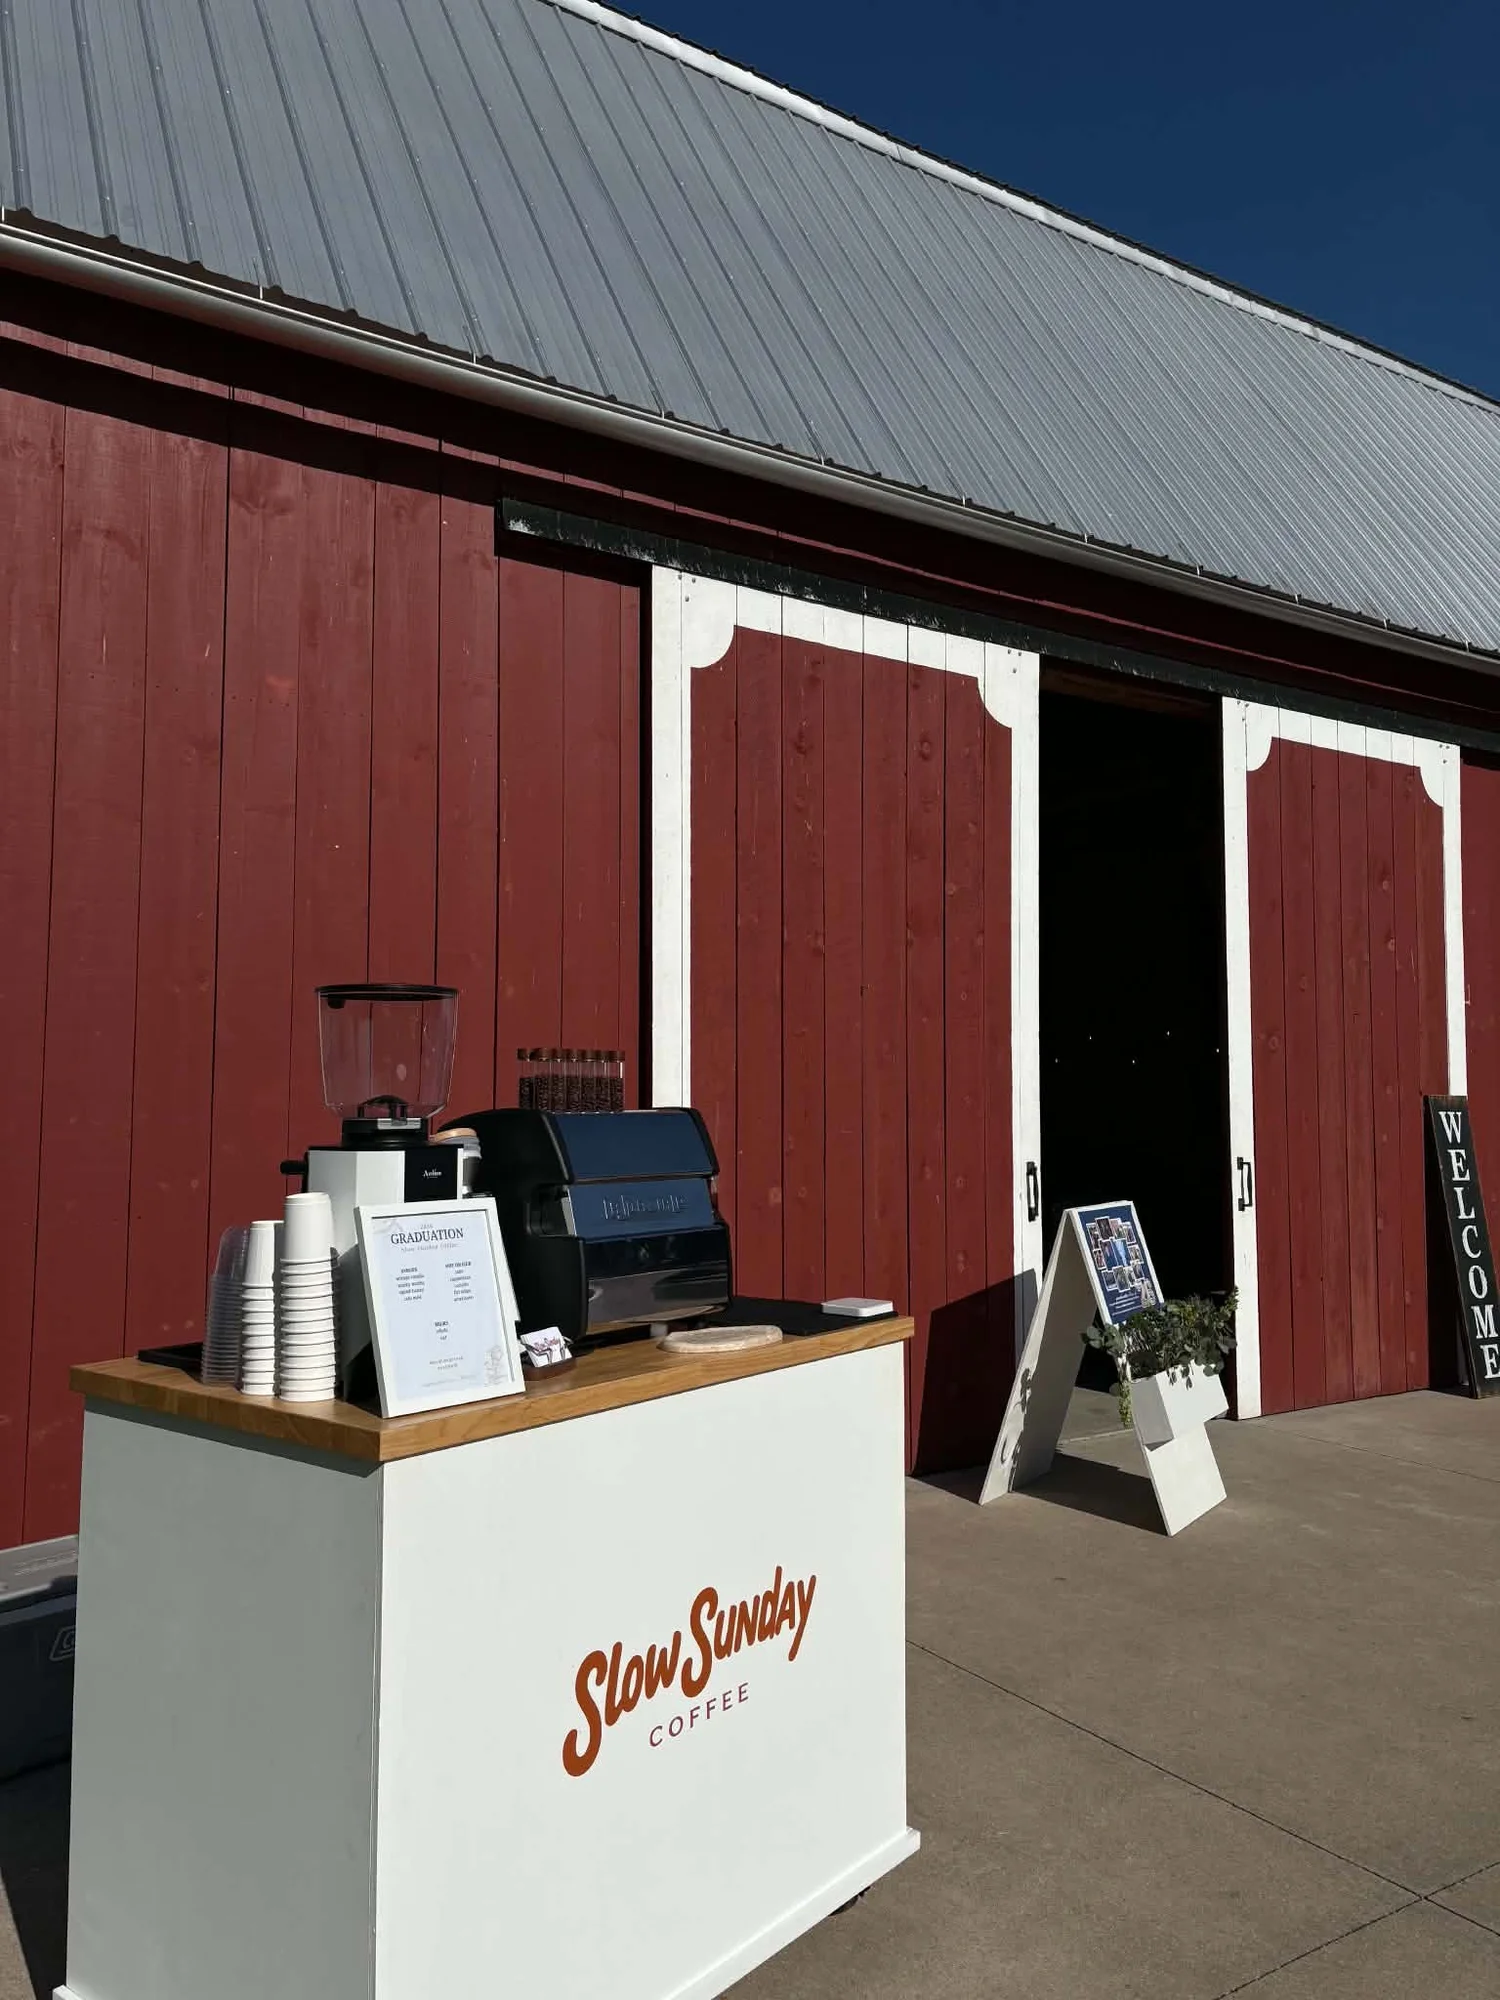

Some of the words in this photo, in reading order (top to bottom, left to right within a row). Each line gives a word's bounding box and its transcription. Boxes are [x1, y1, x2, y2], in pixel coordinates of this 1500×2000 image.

[390, 1228, 464, 1244] GRADUATION
[1438, 1111, 1500, 1379] WELCOME
[649, 1682, 749, 1748] COFFEE
